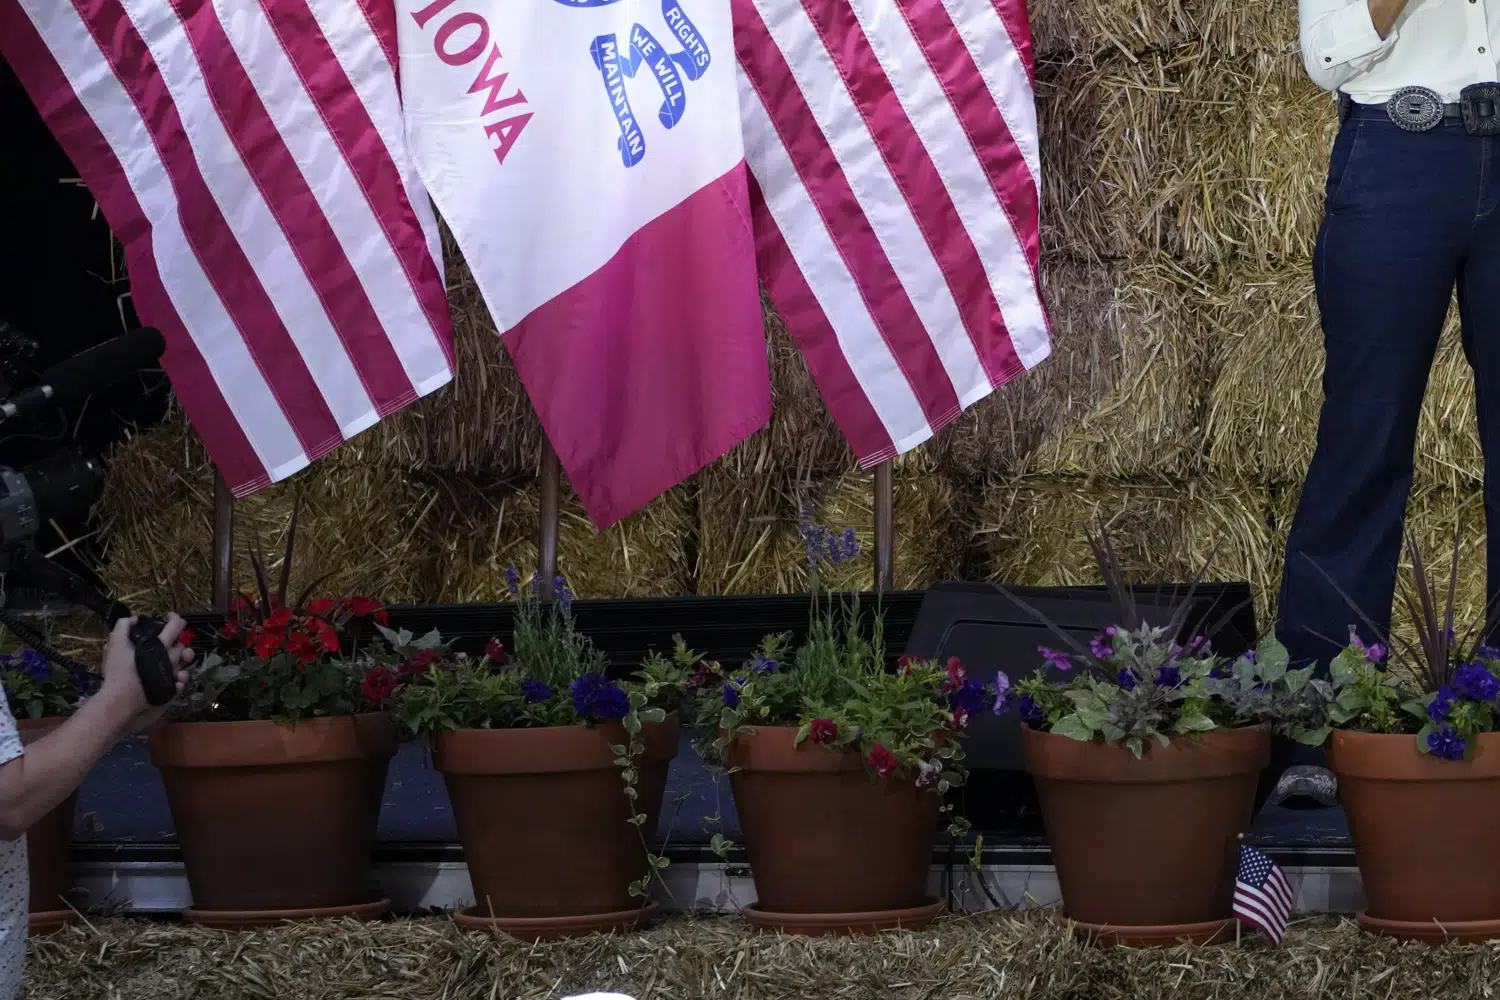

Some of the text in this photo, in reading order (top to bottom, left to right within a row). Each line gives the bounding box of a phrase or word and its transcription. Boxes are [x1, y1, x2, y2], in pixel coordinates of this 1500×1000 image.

[633, 30, 682, 108] WE WILL
[666, 7, 710, 67] RIGHTS
[600, 41, 644, 157] MAINTAIN
